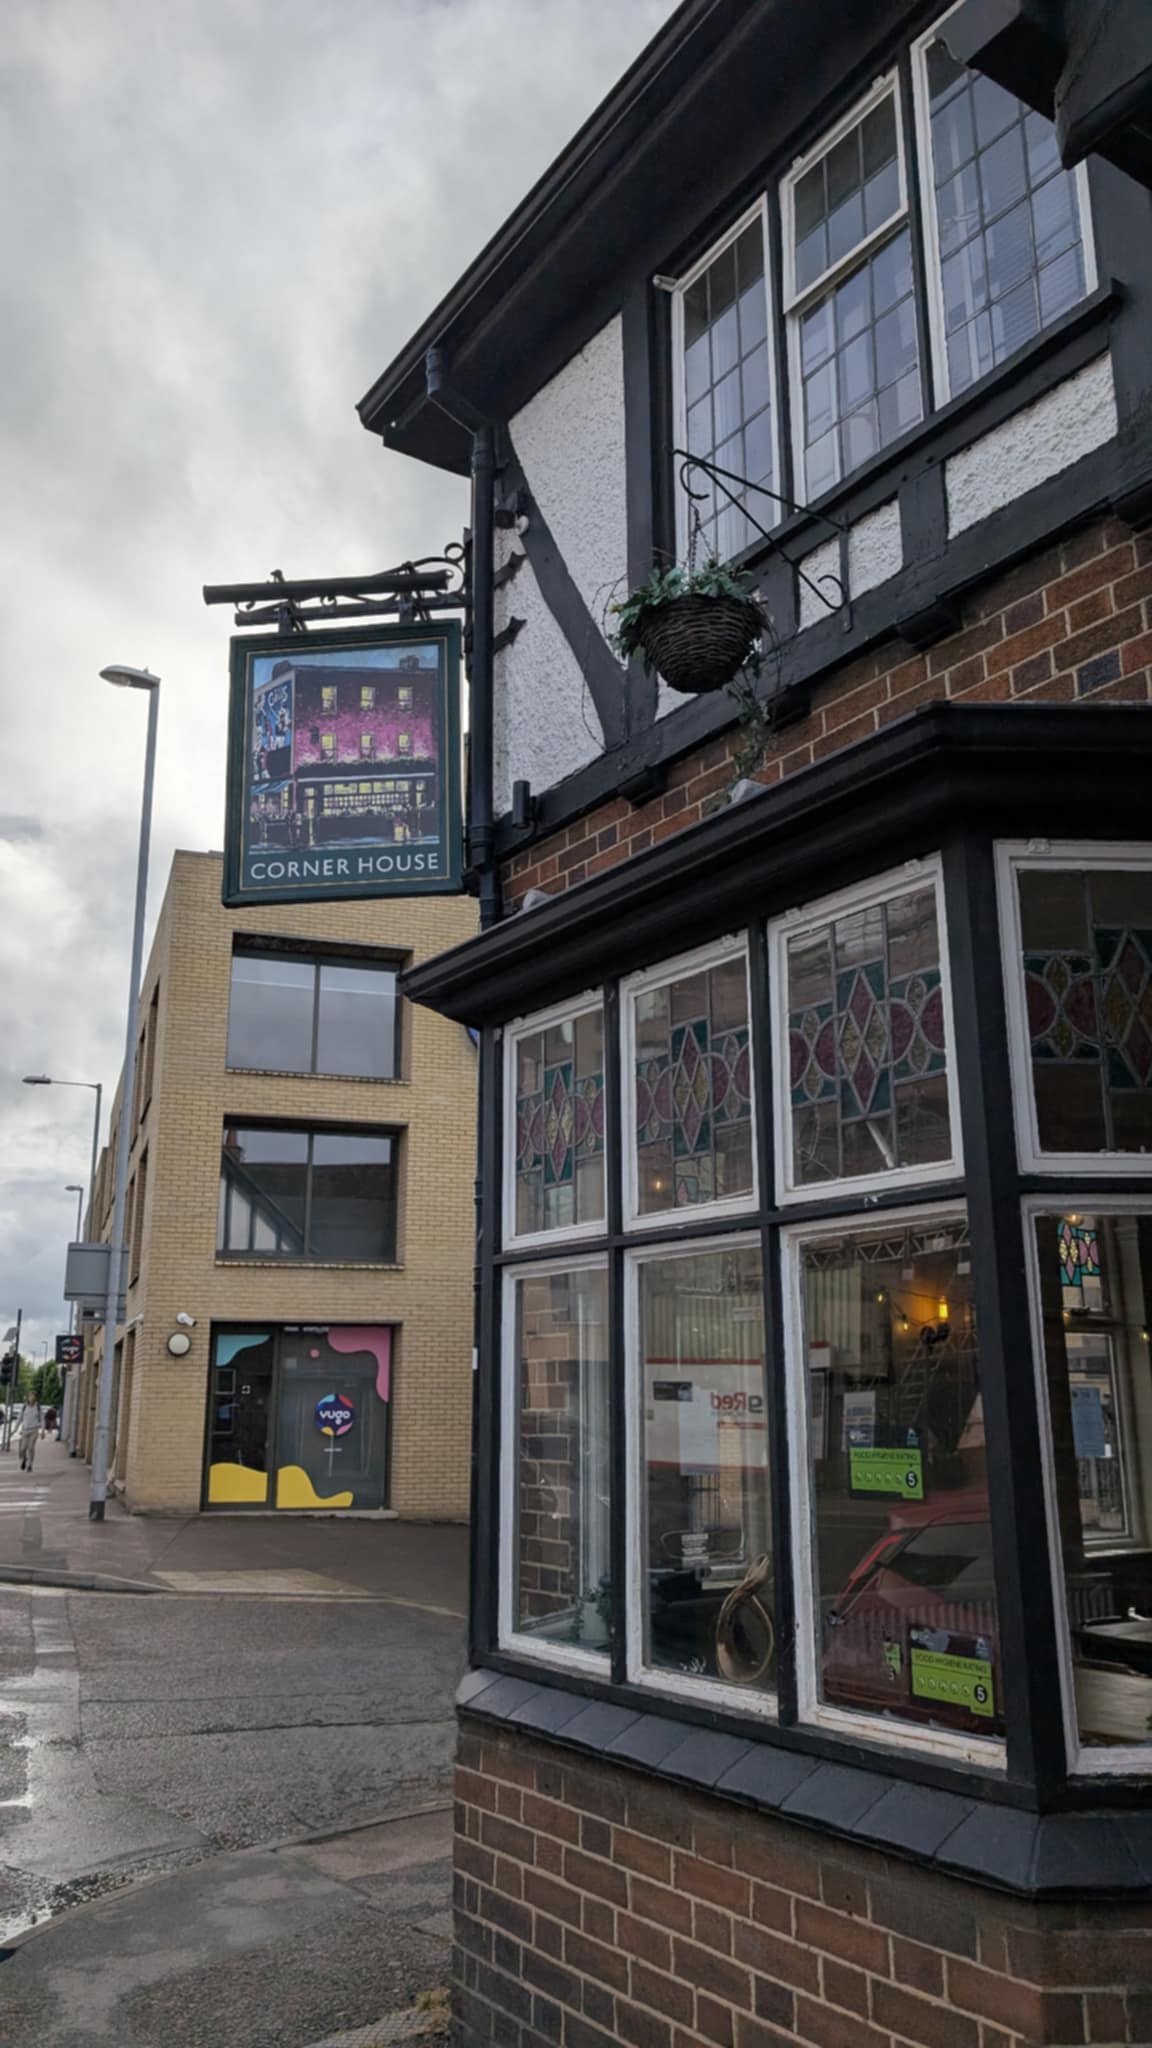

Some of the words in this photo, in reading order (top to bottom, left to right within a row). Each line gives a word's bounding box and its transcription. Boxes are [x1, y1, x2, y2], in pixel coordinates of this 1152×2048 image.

[250, 859, 350, 880] CORNER
[358, 853, 439, 874] HOUSE
[907, 1472, 916, 1487] 5
[977, 1687, 986, 1702] 5
